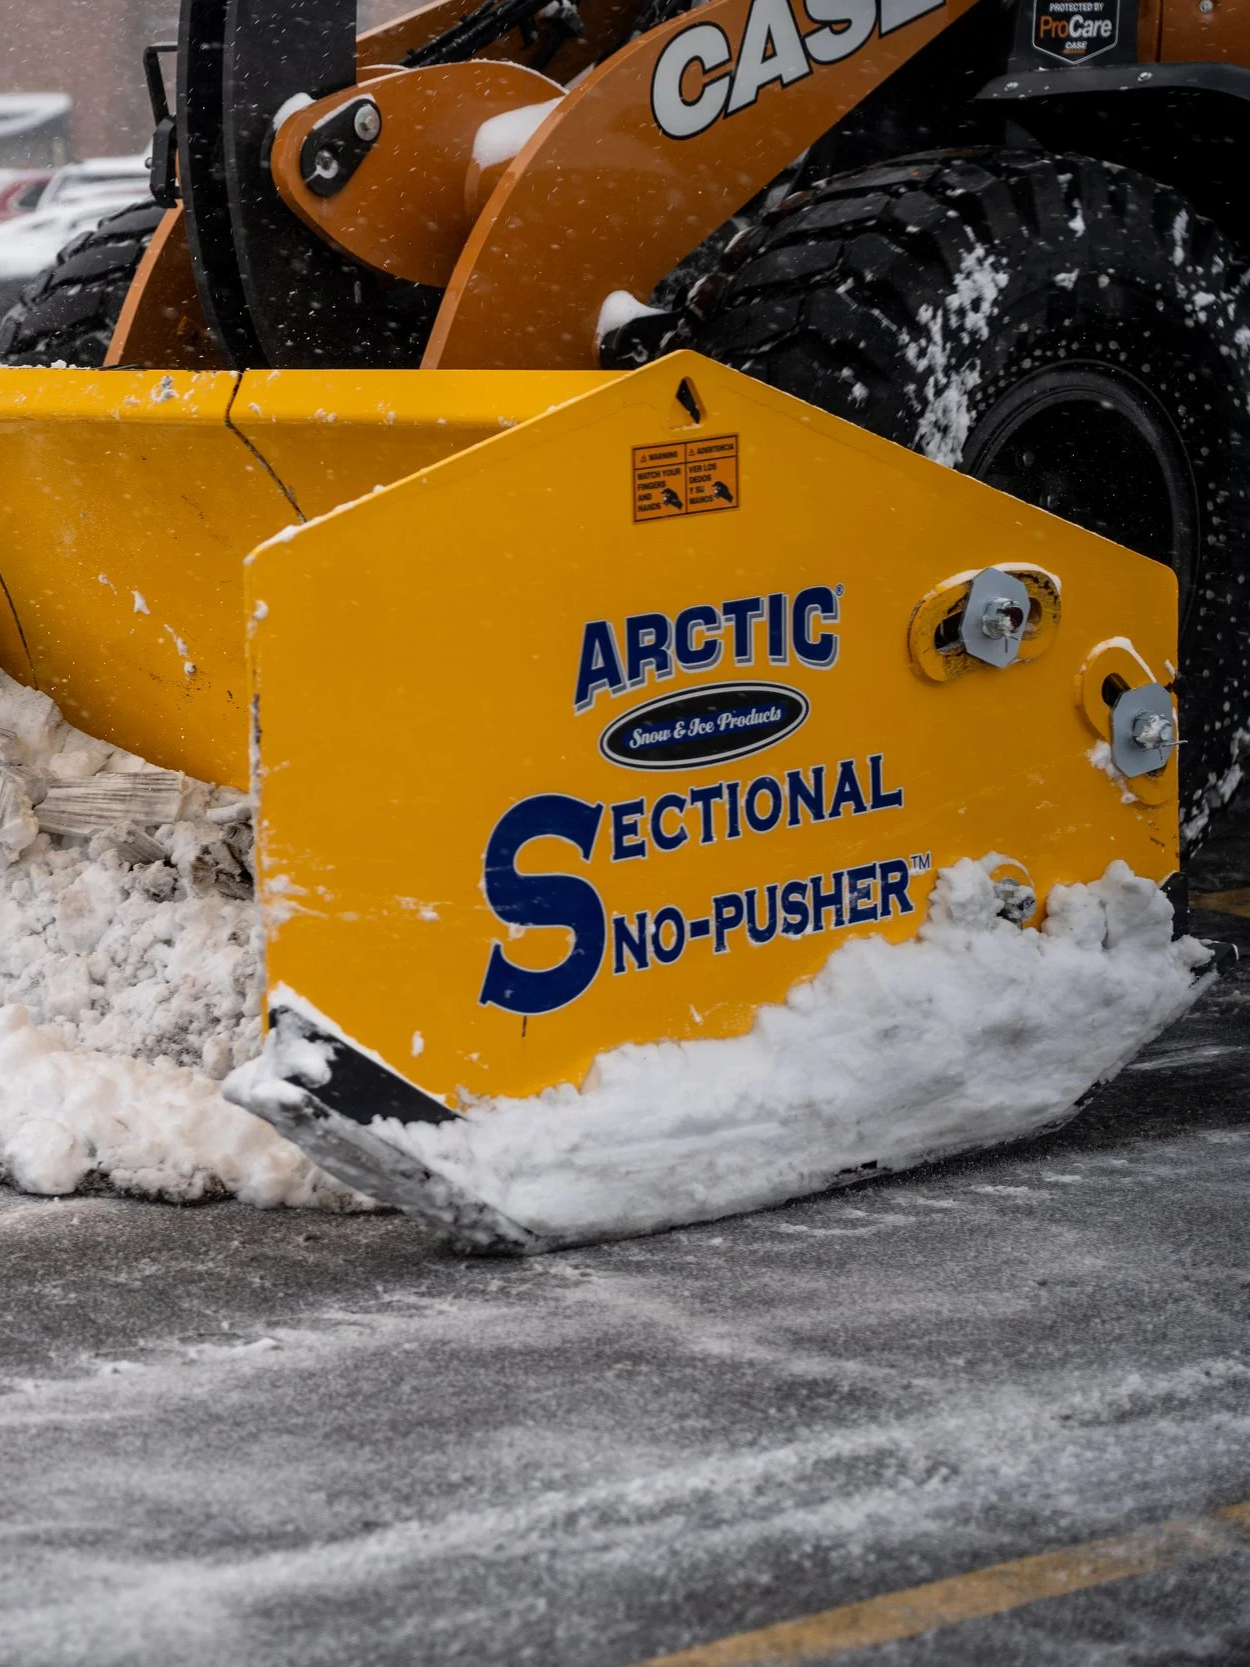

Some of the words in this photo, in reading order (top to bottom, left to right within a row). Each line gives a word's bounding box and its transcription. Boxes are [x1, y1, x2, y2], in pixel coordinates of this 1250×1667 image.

[1049, 3, 1093, 12] PROTECTED
[1094, 2, 1104, 11] BY
[1040, 14, 1112, 38] ProCare
[1065, 41, 1087, 50] CASE
[648, 451, 678, 461] WARNING
[689, 465, 702, 473] VER
[704, 463, 717, 472] LOS
[637, 471, 660, 480] WATCH
[662, 468, 681, 477] YOUR
[689, 474, 711, 484] DEDOS
[637, 481, 666, 491] FINGERS
[638, 493, 652, 502] AND
[638, 503, 661, 512] HANDS
[629, 728, 671, 749] Snow
[673, 720, 686, 739] &
[687, 718, 715, 737] Ice
[717, 706, 782, 731] Products
